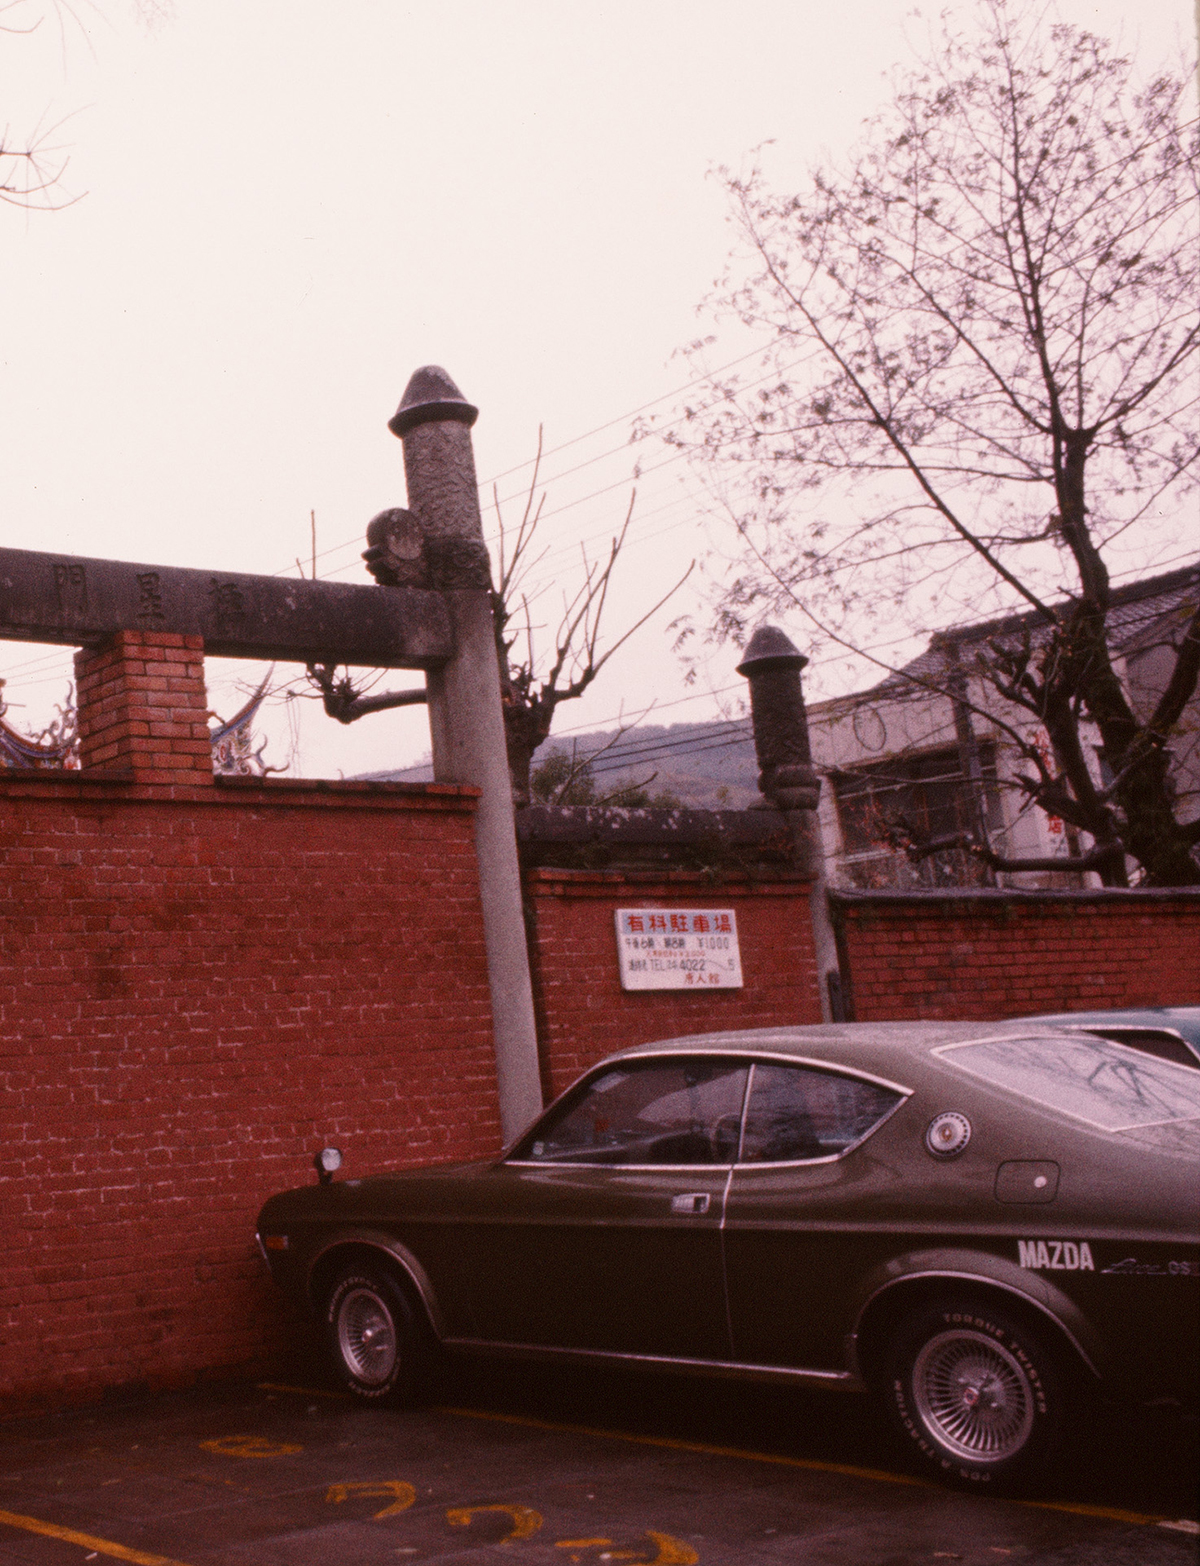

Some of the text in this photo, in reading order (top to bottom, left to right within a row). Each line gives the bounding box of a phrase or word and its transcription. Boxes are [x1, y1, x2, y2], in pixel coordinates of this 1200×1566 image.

[627, 914, 732, 933] 有料駐車場
[1017, 1240, 1095, 1271] MAZDA
[943, 1312, 1005, 1338] TORQUE
